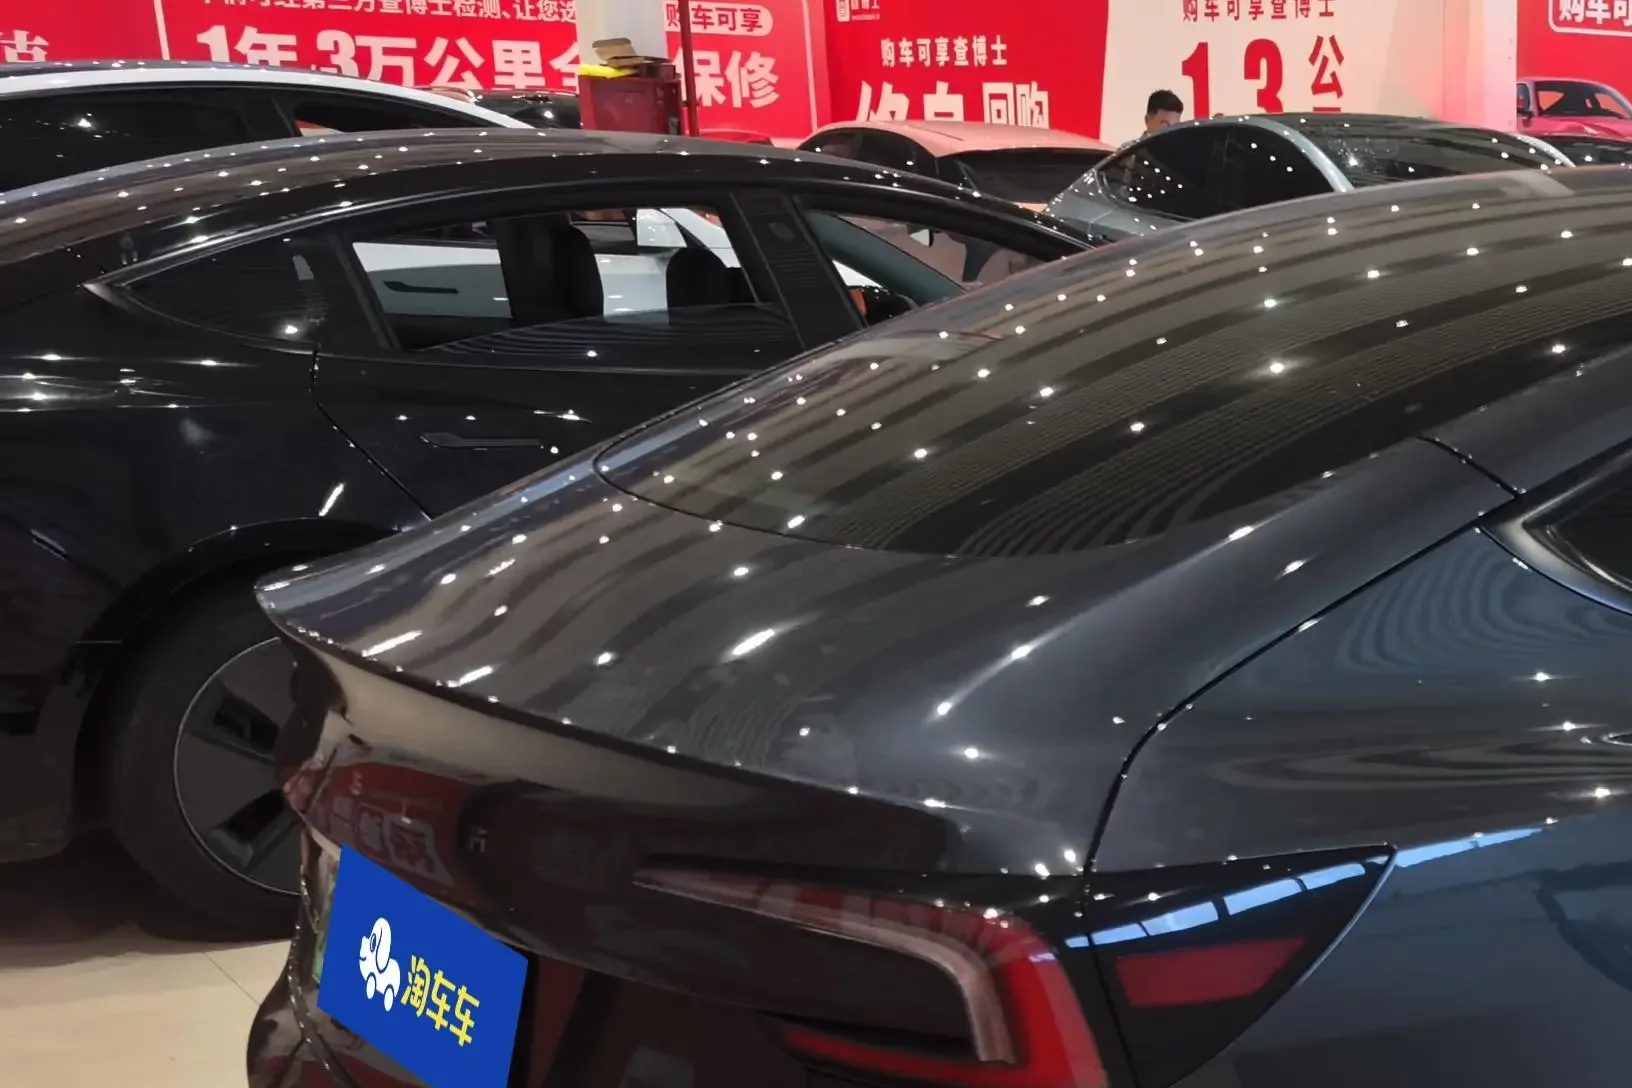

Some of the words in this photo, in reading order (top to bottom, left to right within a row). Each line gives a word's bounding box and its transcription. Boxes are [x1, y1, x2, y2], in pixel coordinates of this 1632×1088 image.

[880, 34, 1008, 68] 购车可享查博士
